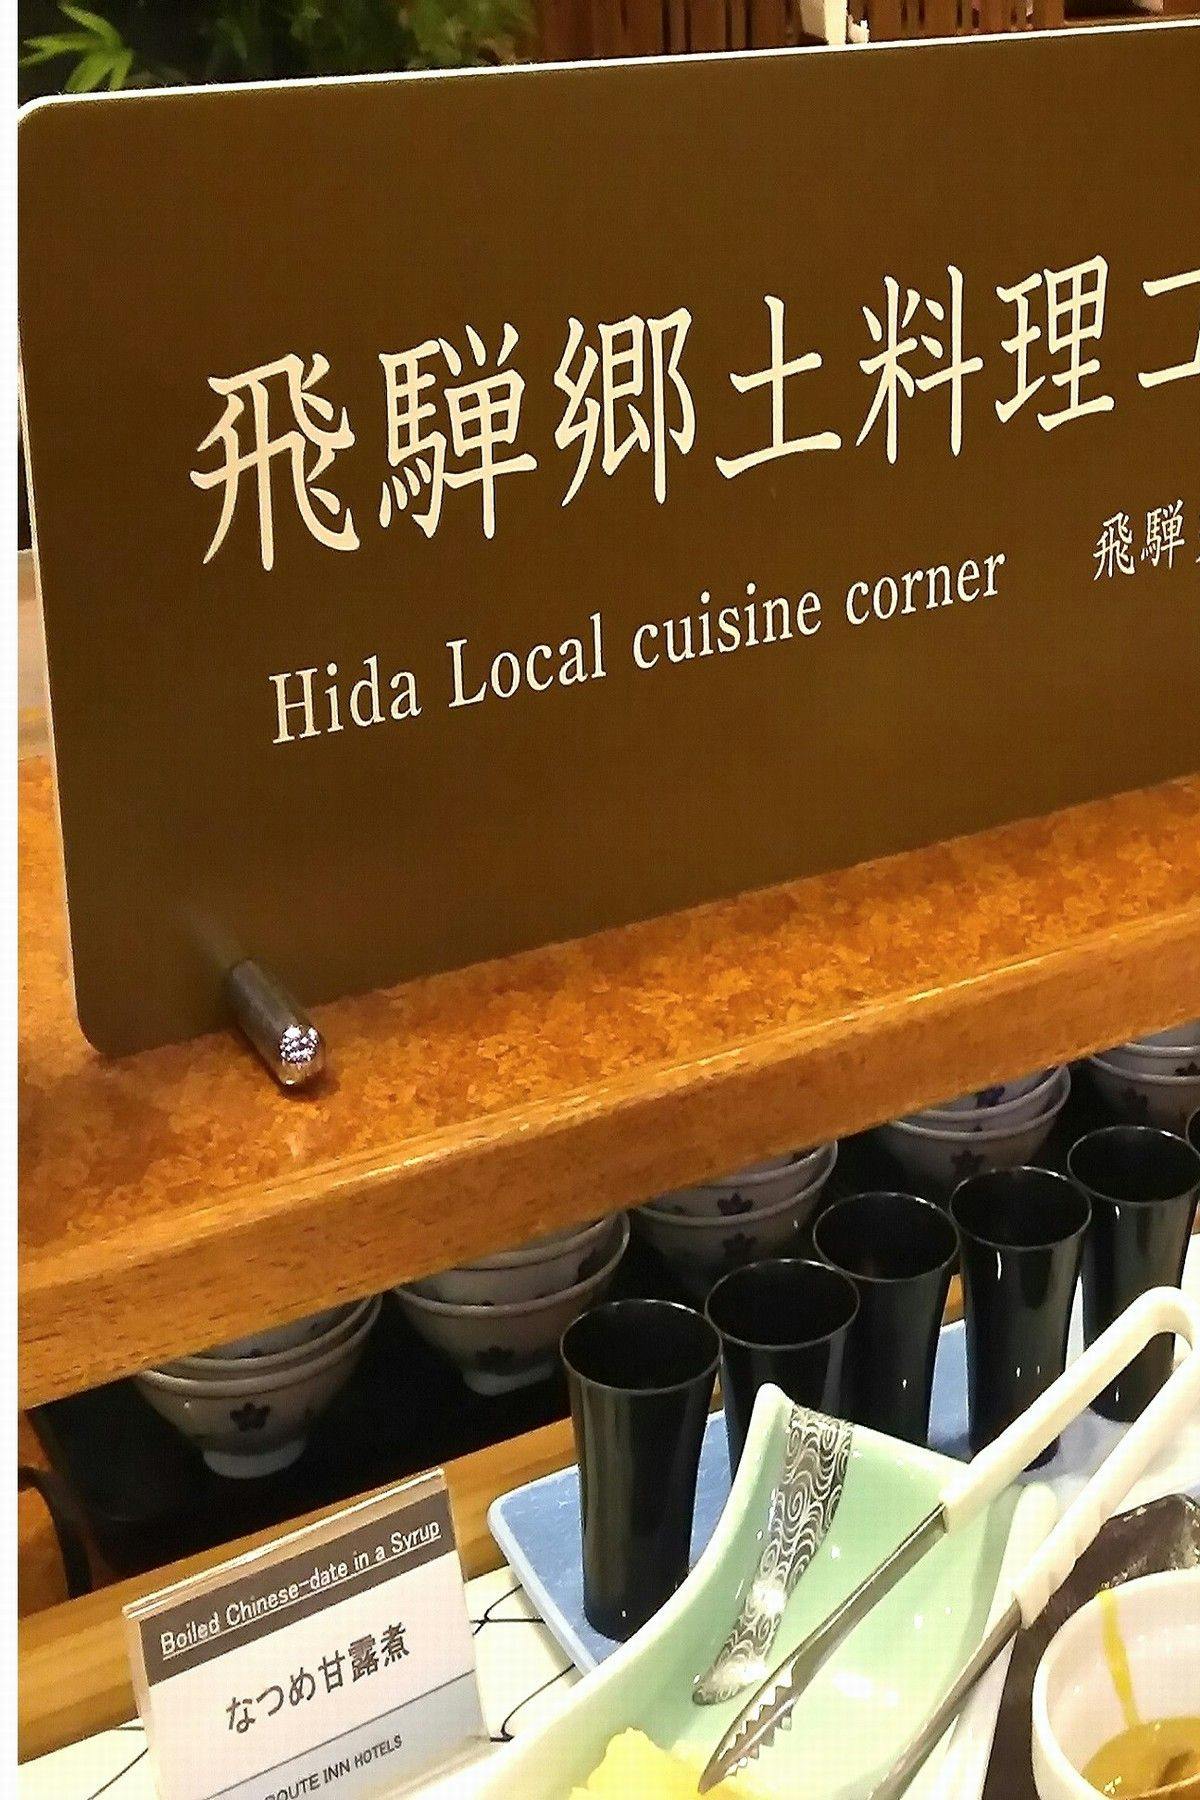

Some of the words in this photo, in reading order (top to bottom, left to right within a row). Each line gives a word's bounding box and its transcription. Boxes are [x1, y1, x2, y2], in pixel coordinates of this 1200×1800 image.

[269, 656, 422, 744] Hida
[446, 612, 607, 708] Local
[632, 583, 822, 670] cuisine
[847, 549, 1006, 626] corner
[160, 1611, 221, 1655] Boiled
[226, 1562, 349, 1626] Chinese-date
[353, 1550, 370, 1572] in
[374, 1545, 387, 1563] a
[390, 1520, 441, 1555] Syrup
[225, 1622, 411, 1734] なつめ甘露煮
[322, 1758, 351, 1784] INN
[353, 1734, 404, 1770] HOTELS
